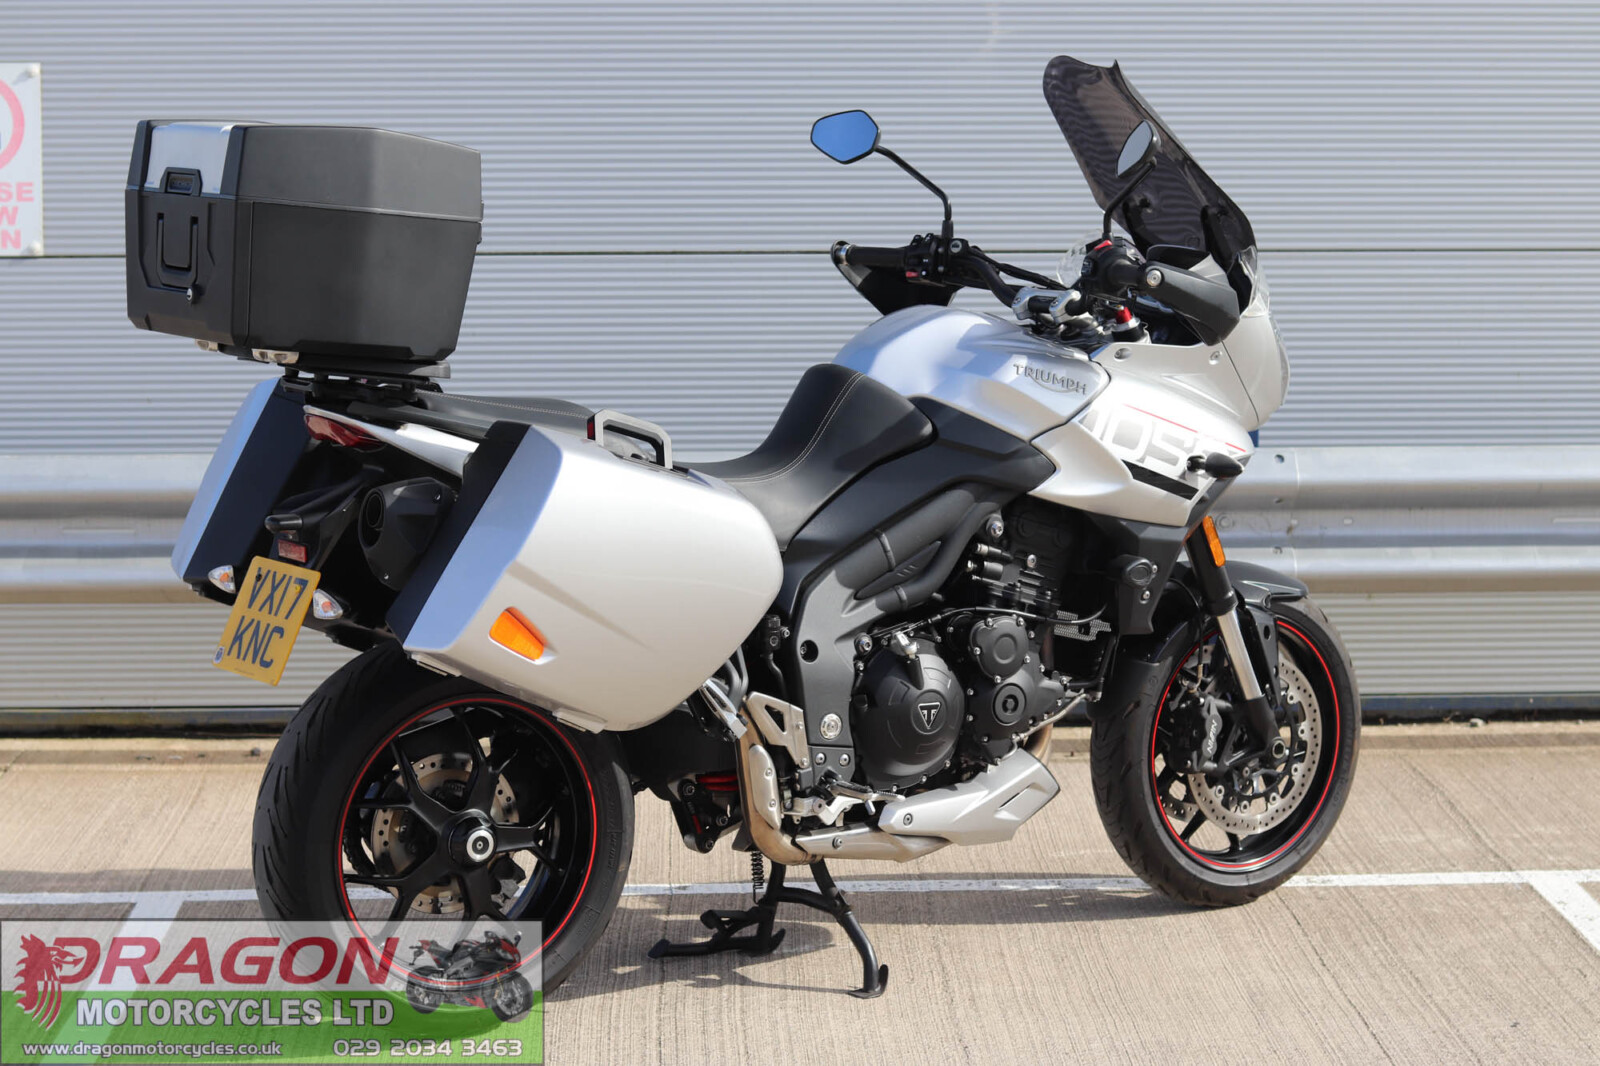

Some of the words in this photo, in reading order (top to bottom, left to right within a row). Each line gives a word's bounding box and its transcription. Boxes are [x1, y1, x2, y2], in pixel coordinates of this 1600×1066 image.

[1013, 363, 1087, 395] TRIUMPH
[248, 567, 309, 619] VX17
[227, 615, 285, 669] KNC
